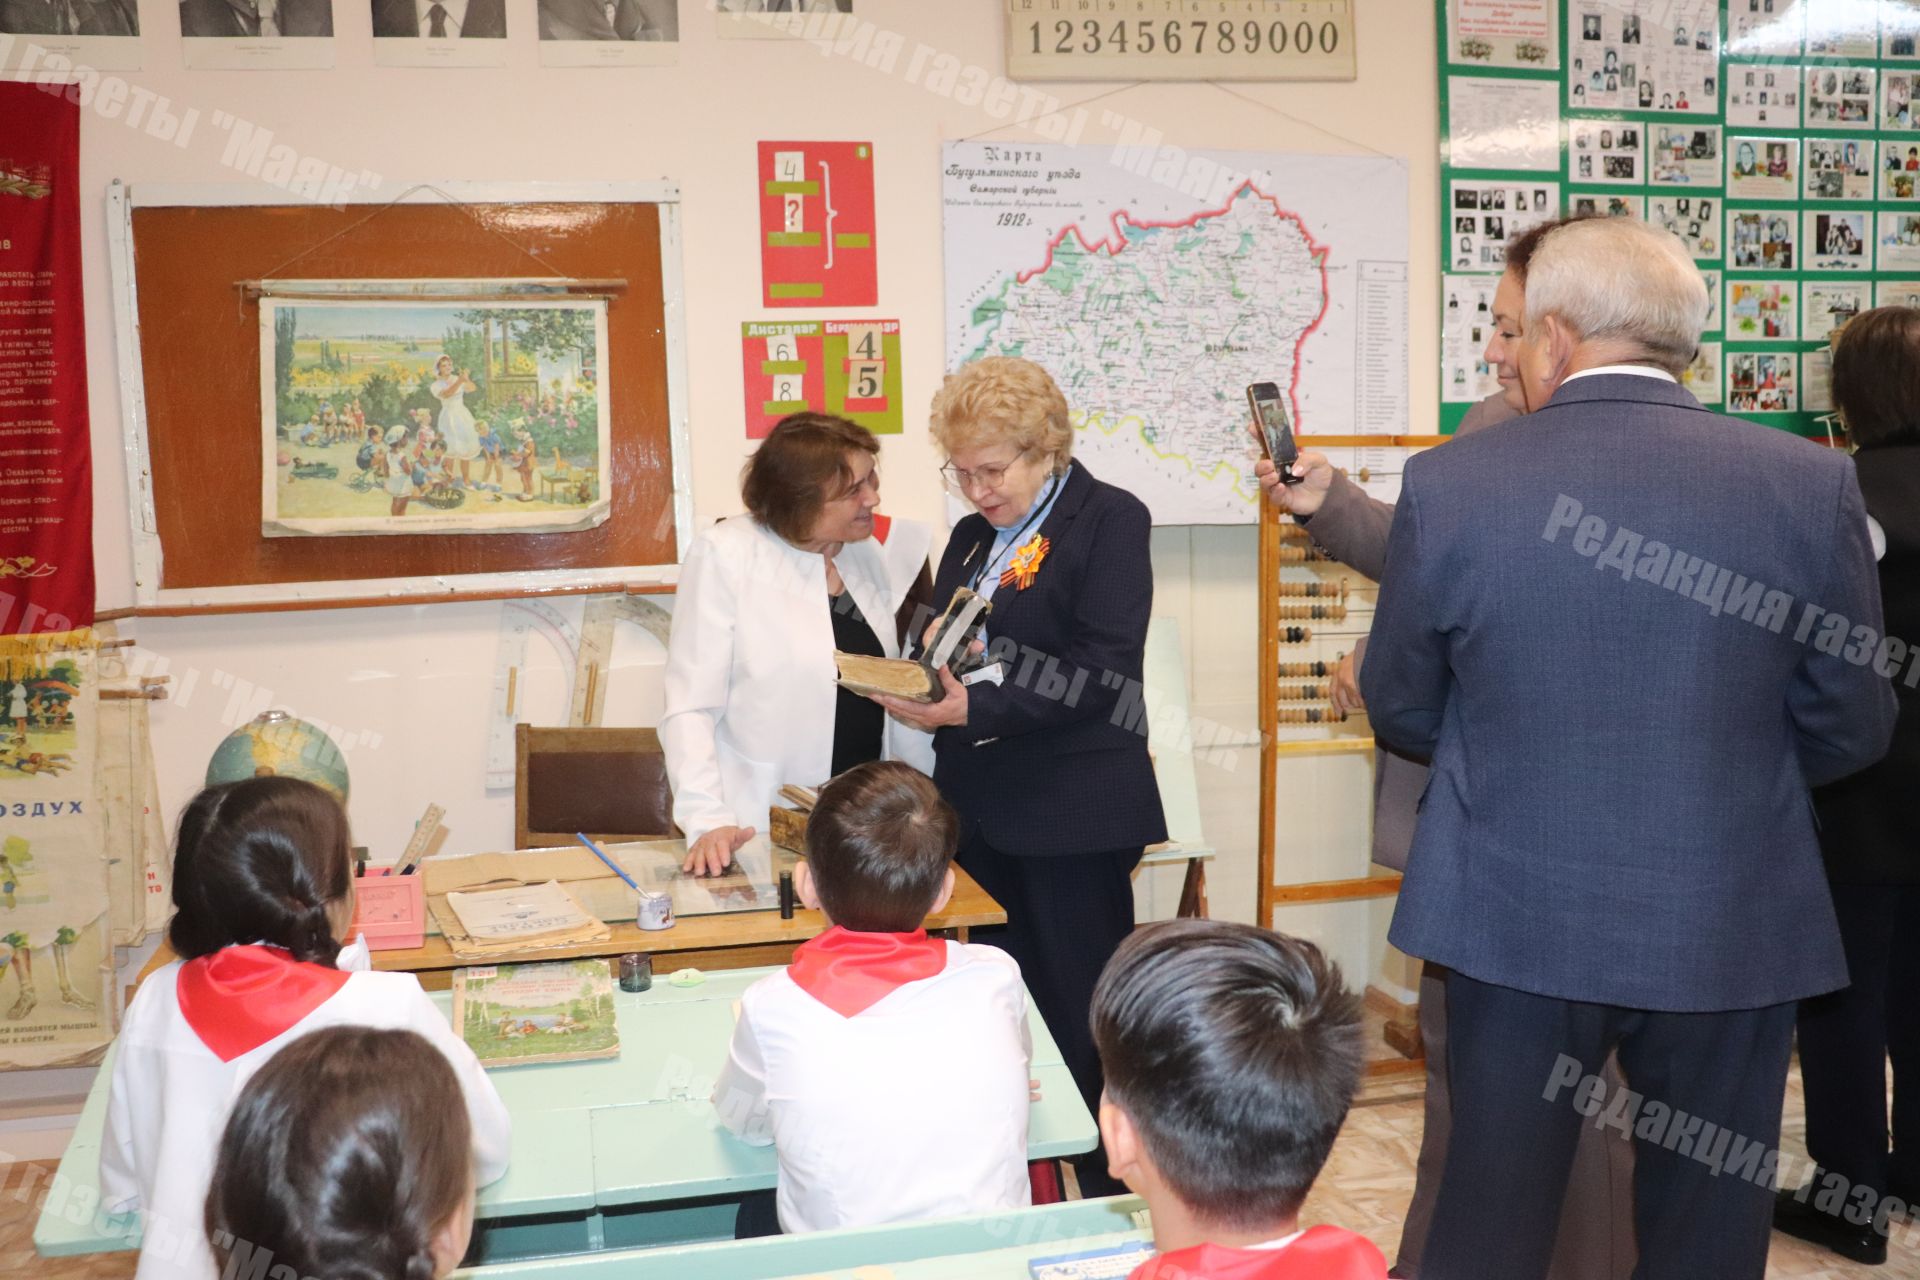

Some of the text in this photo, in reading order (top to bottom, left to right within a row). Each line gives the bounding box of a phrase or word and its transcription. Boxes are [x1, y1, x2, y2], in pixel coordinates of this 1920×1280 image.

[1108, 1, 1116, 11] 9
[1136, 2, 1144, 11] 8
[1165, 2, 1172, 11] 7
[1192, 2, 1199, 12] 6
[1218, 2, 1226, 12] 5
[1273, 3, 1281, 13] 3
[1301, 3, 1308, 13] 2
[984, 146, 1042, 165] Карта
[996, 212, 1027, 227] 1912
[776, 343, 790, 362] 6
[856, 331, 876, 360] 4
[857, 366, 878, 398] 5
[779, 382, 792, 402] 8
